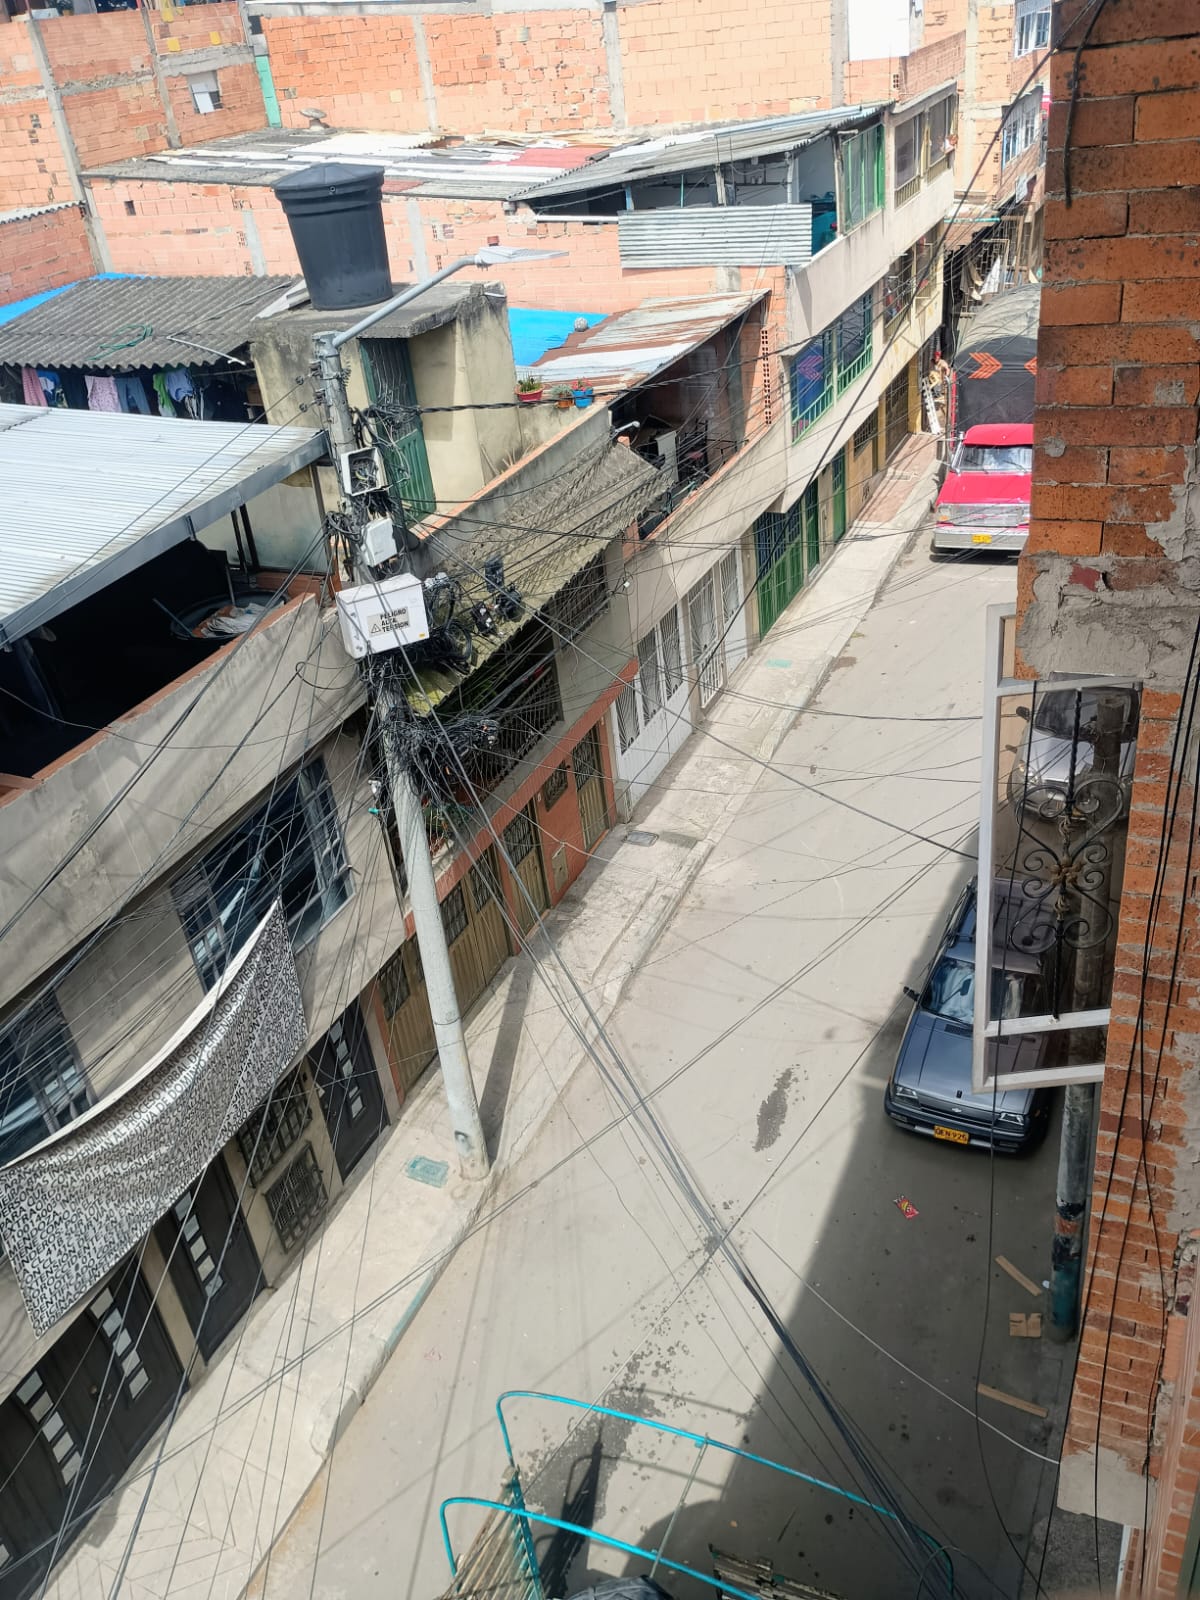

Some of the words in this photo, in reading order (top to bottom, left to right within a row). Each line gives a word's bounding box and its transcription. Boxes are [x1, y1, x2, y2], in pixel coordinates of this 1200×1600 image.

[380, 608, 407, 620] PELIGRO
[381, 618, 398, 626] ALTA
[122, 1091, 160, 1129] PROCESO
[157, 1063, 189, 1090] VERBAL
[154, 1096, 170, 1112] DE
[39, 1210, 69, 1239] COMO
